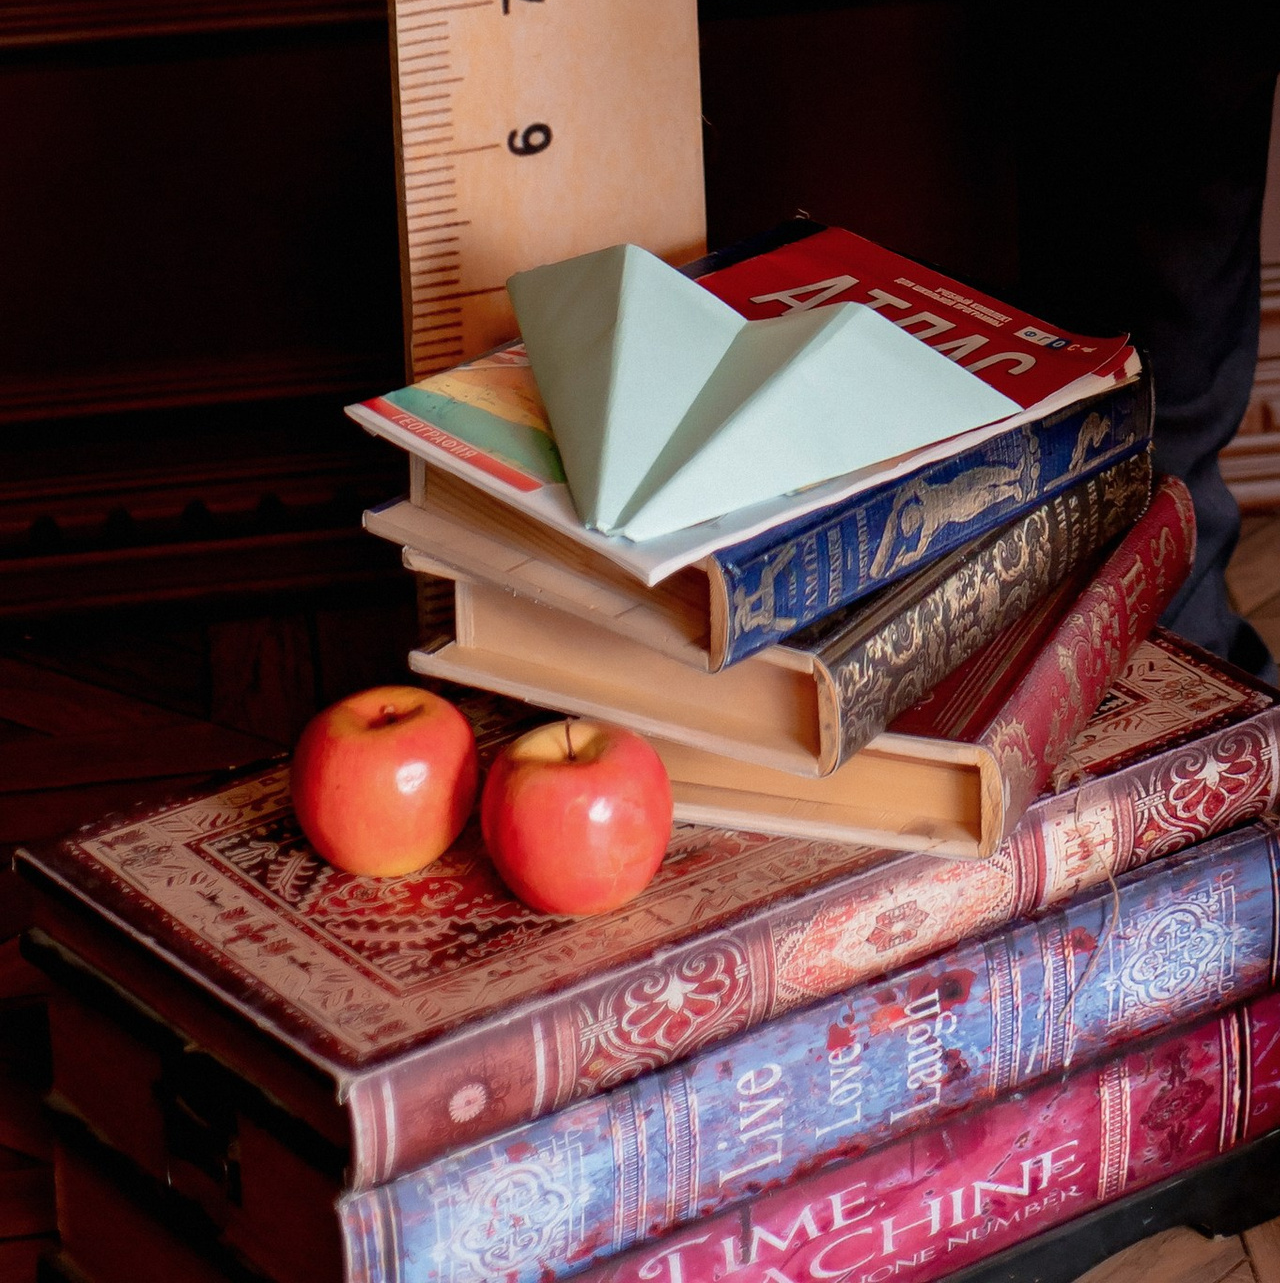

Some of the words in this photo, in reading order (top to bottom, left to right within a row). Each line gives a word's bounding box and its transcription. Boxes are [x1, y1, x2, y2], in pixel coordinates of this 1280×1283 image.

[506, 122, 553, 157] 6
[392, 412, 478, 459] ГЕОГРАФИЯ
[817, 1038, 863, 1139] Love
[890, 988, 958, 1125] Laugh
[719, 1062, 784, 1188] Live
[948, 1185, 1084, 1252] NUMBER
